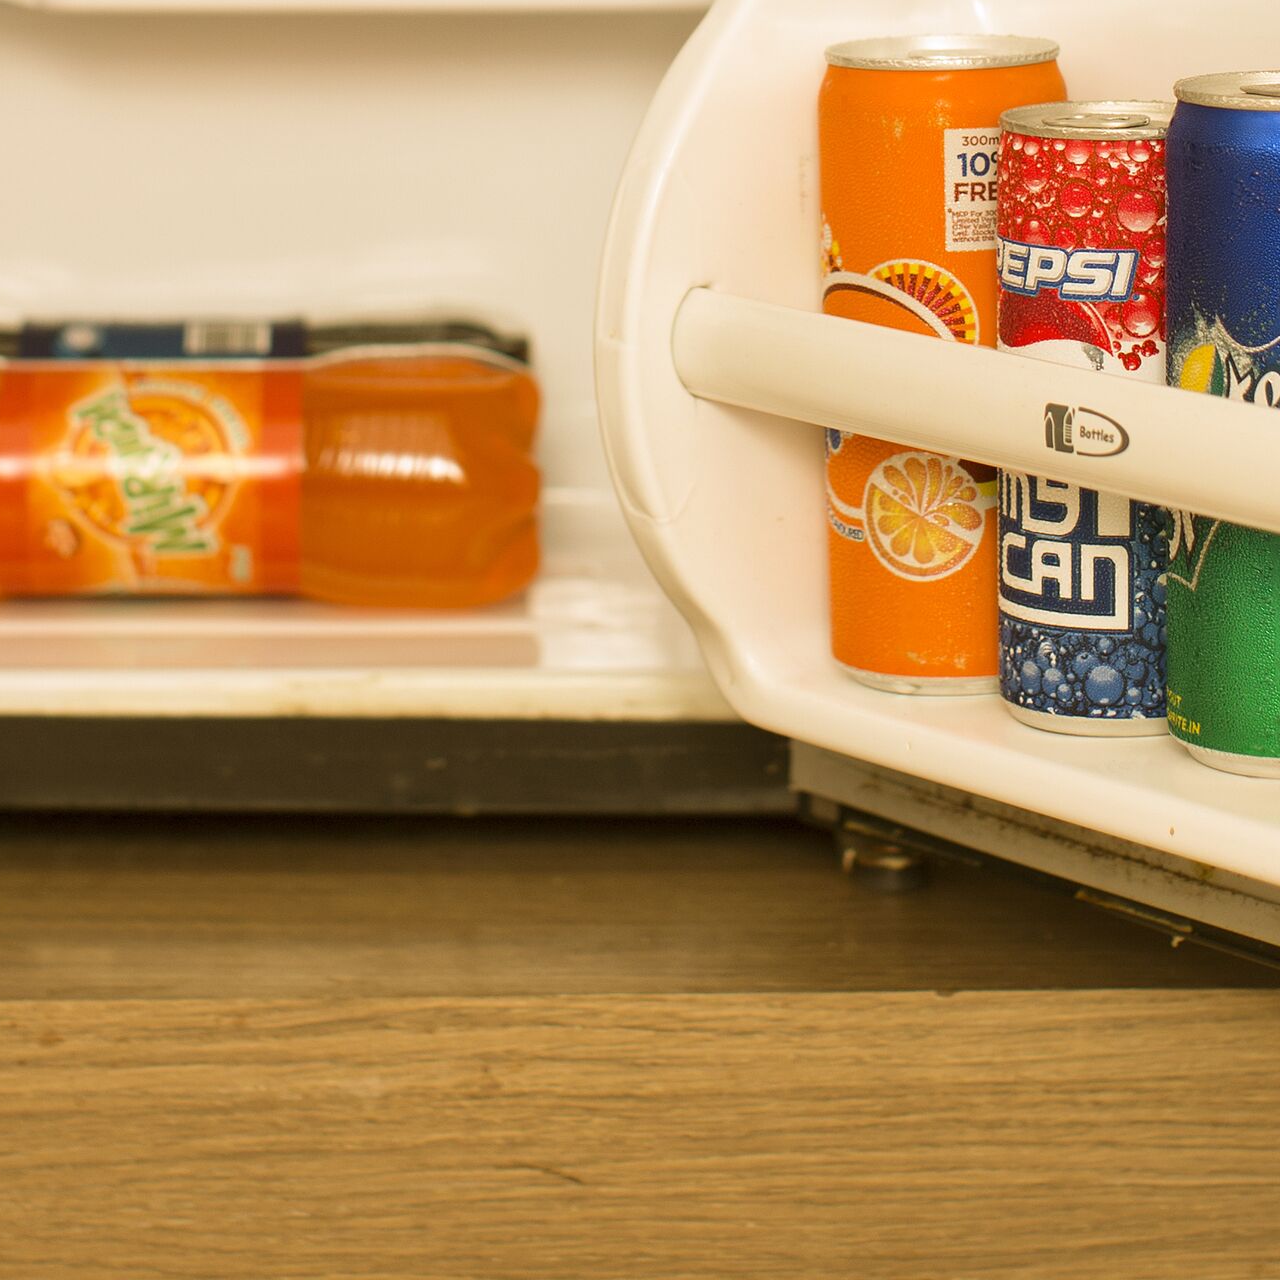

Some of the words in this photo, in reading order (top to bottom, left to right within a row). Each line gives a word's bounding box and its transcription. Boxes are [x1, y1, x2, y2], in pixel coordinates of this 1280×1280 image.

[962, 135, 1000, 147] 300m
[953, 181, 997, 202] FRE
[1079, 425, 1115, 444] Bottles
